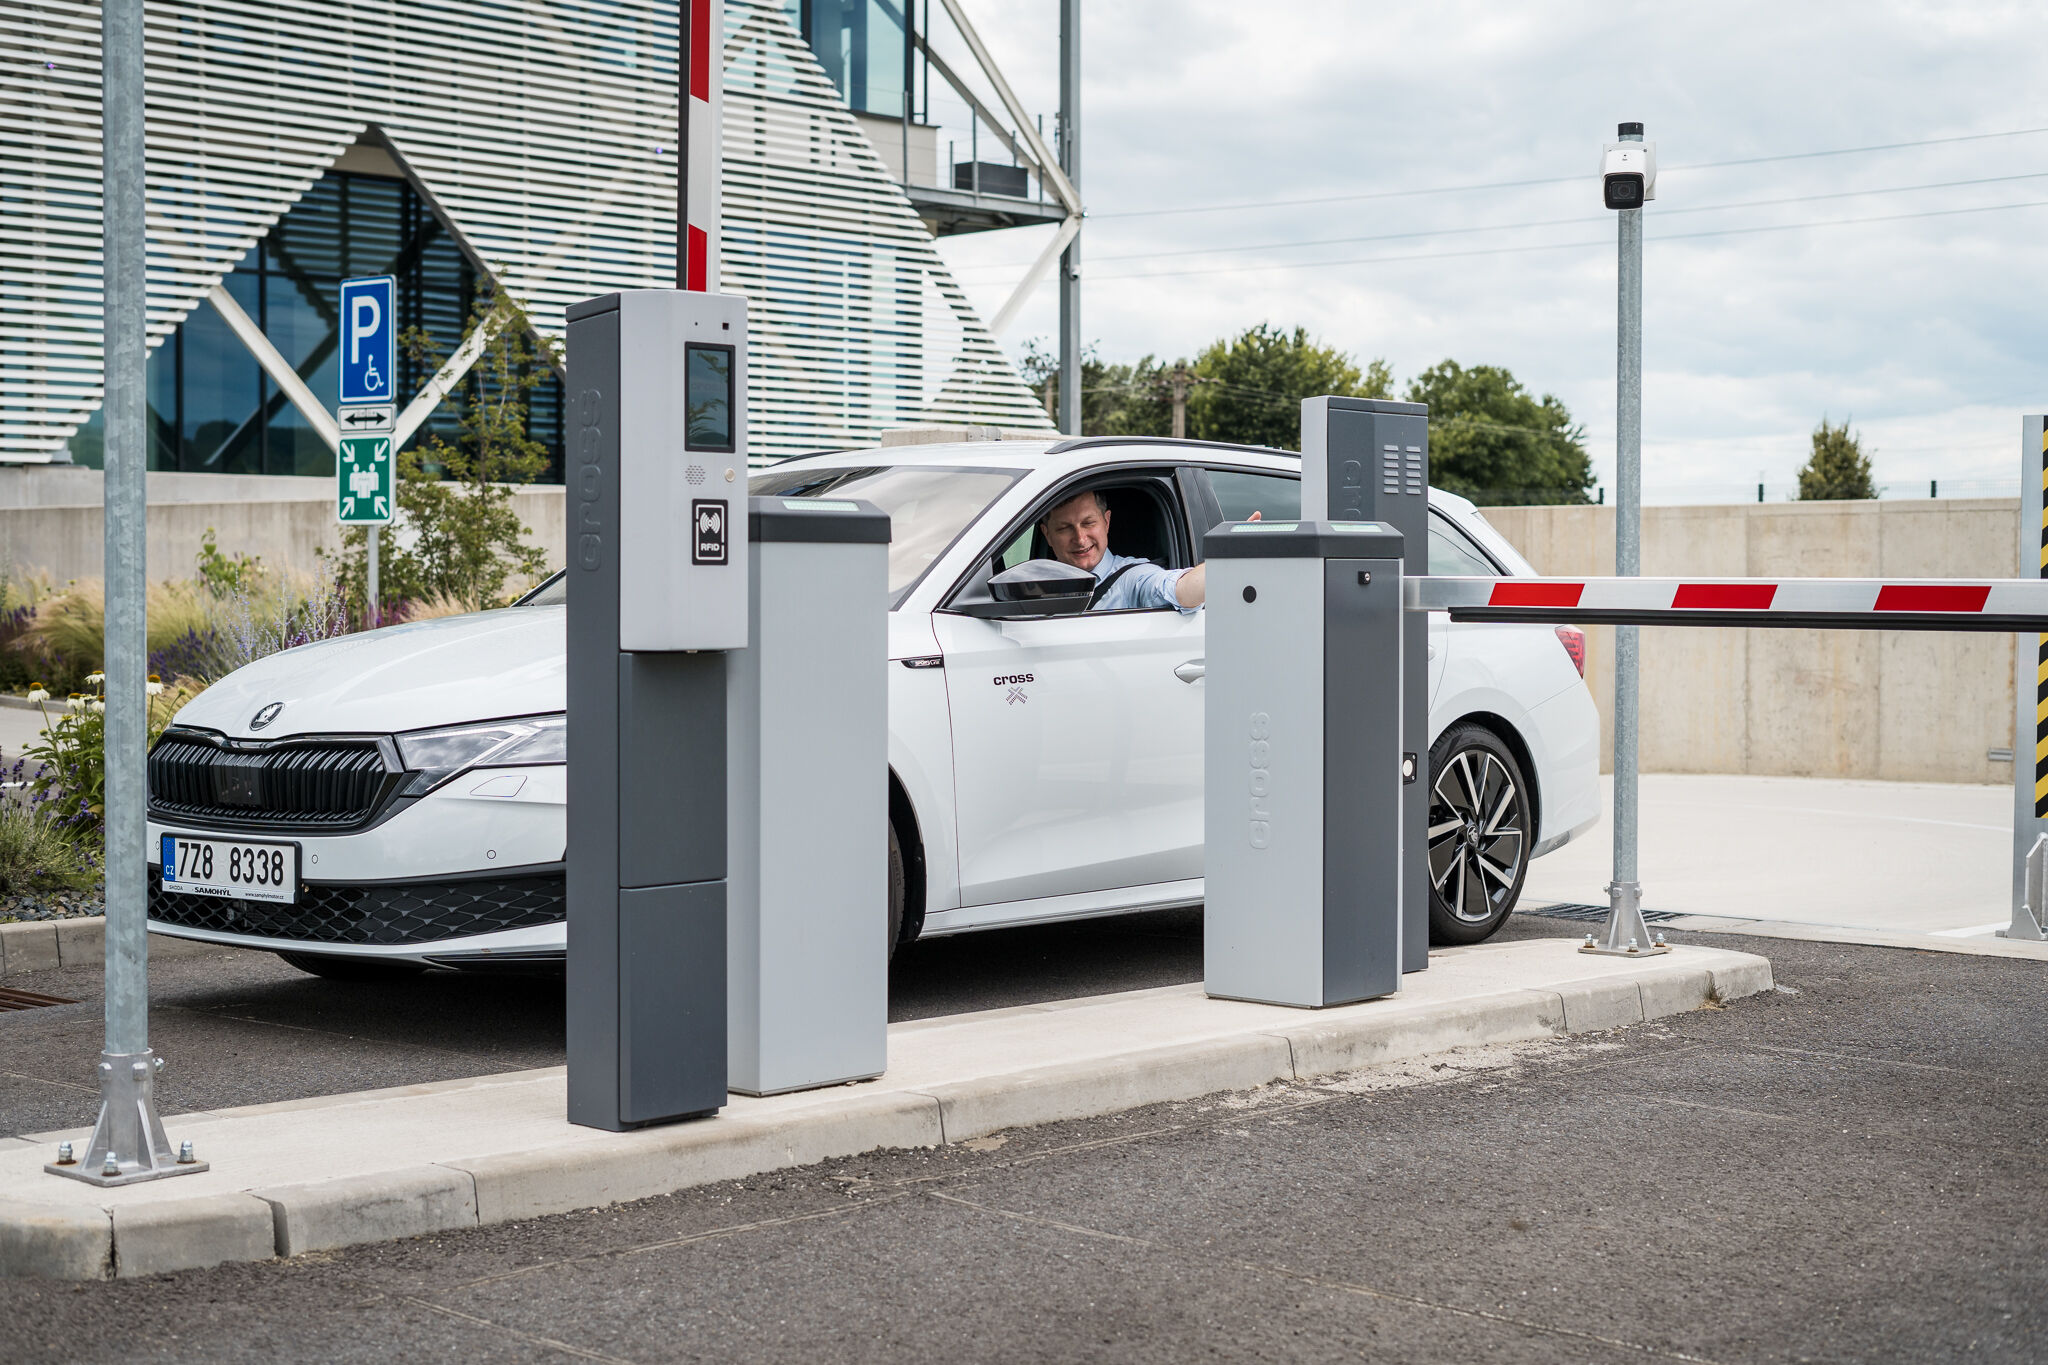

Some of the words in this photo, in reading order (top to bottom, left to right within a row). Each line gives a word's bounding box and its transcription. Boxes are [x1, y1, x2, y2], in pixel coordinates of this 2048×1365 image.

[351, 295, 381, 364] P
[579, 388, 602, 572] cross
[700, 542, 720, 551] RFID
[993, 673, 1035, 686] cross
[1249, 711, 1271, 850] cross
[165, 864, 175, 876] CZ
[178, 842, 214, 879] 7Z8
[229, 847, 284, 886] 8338
[194, 886, 232, 897] SAMOHÝL
